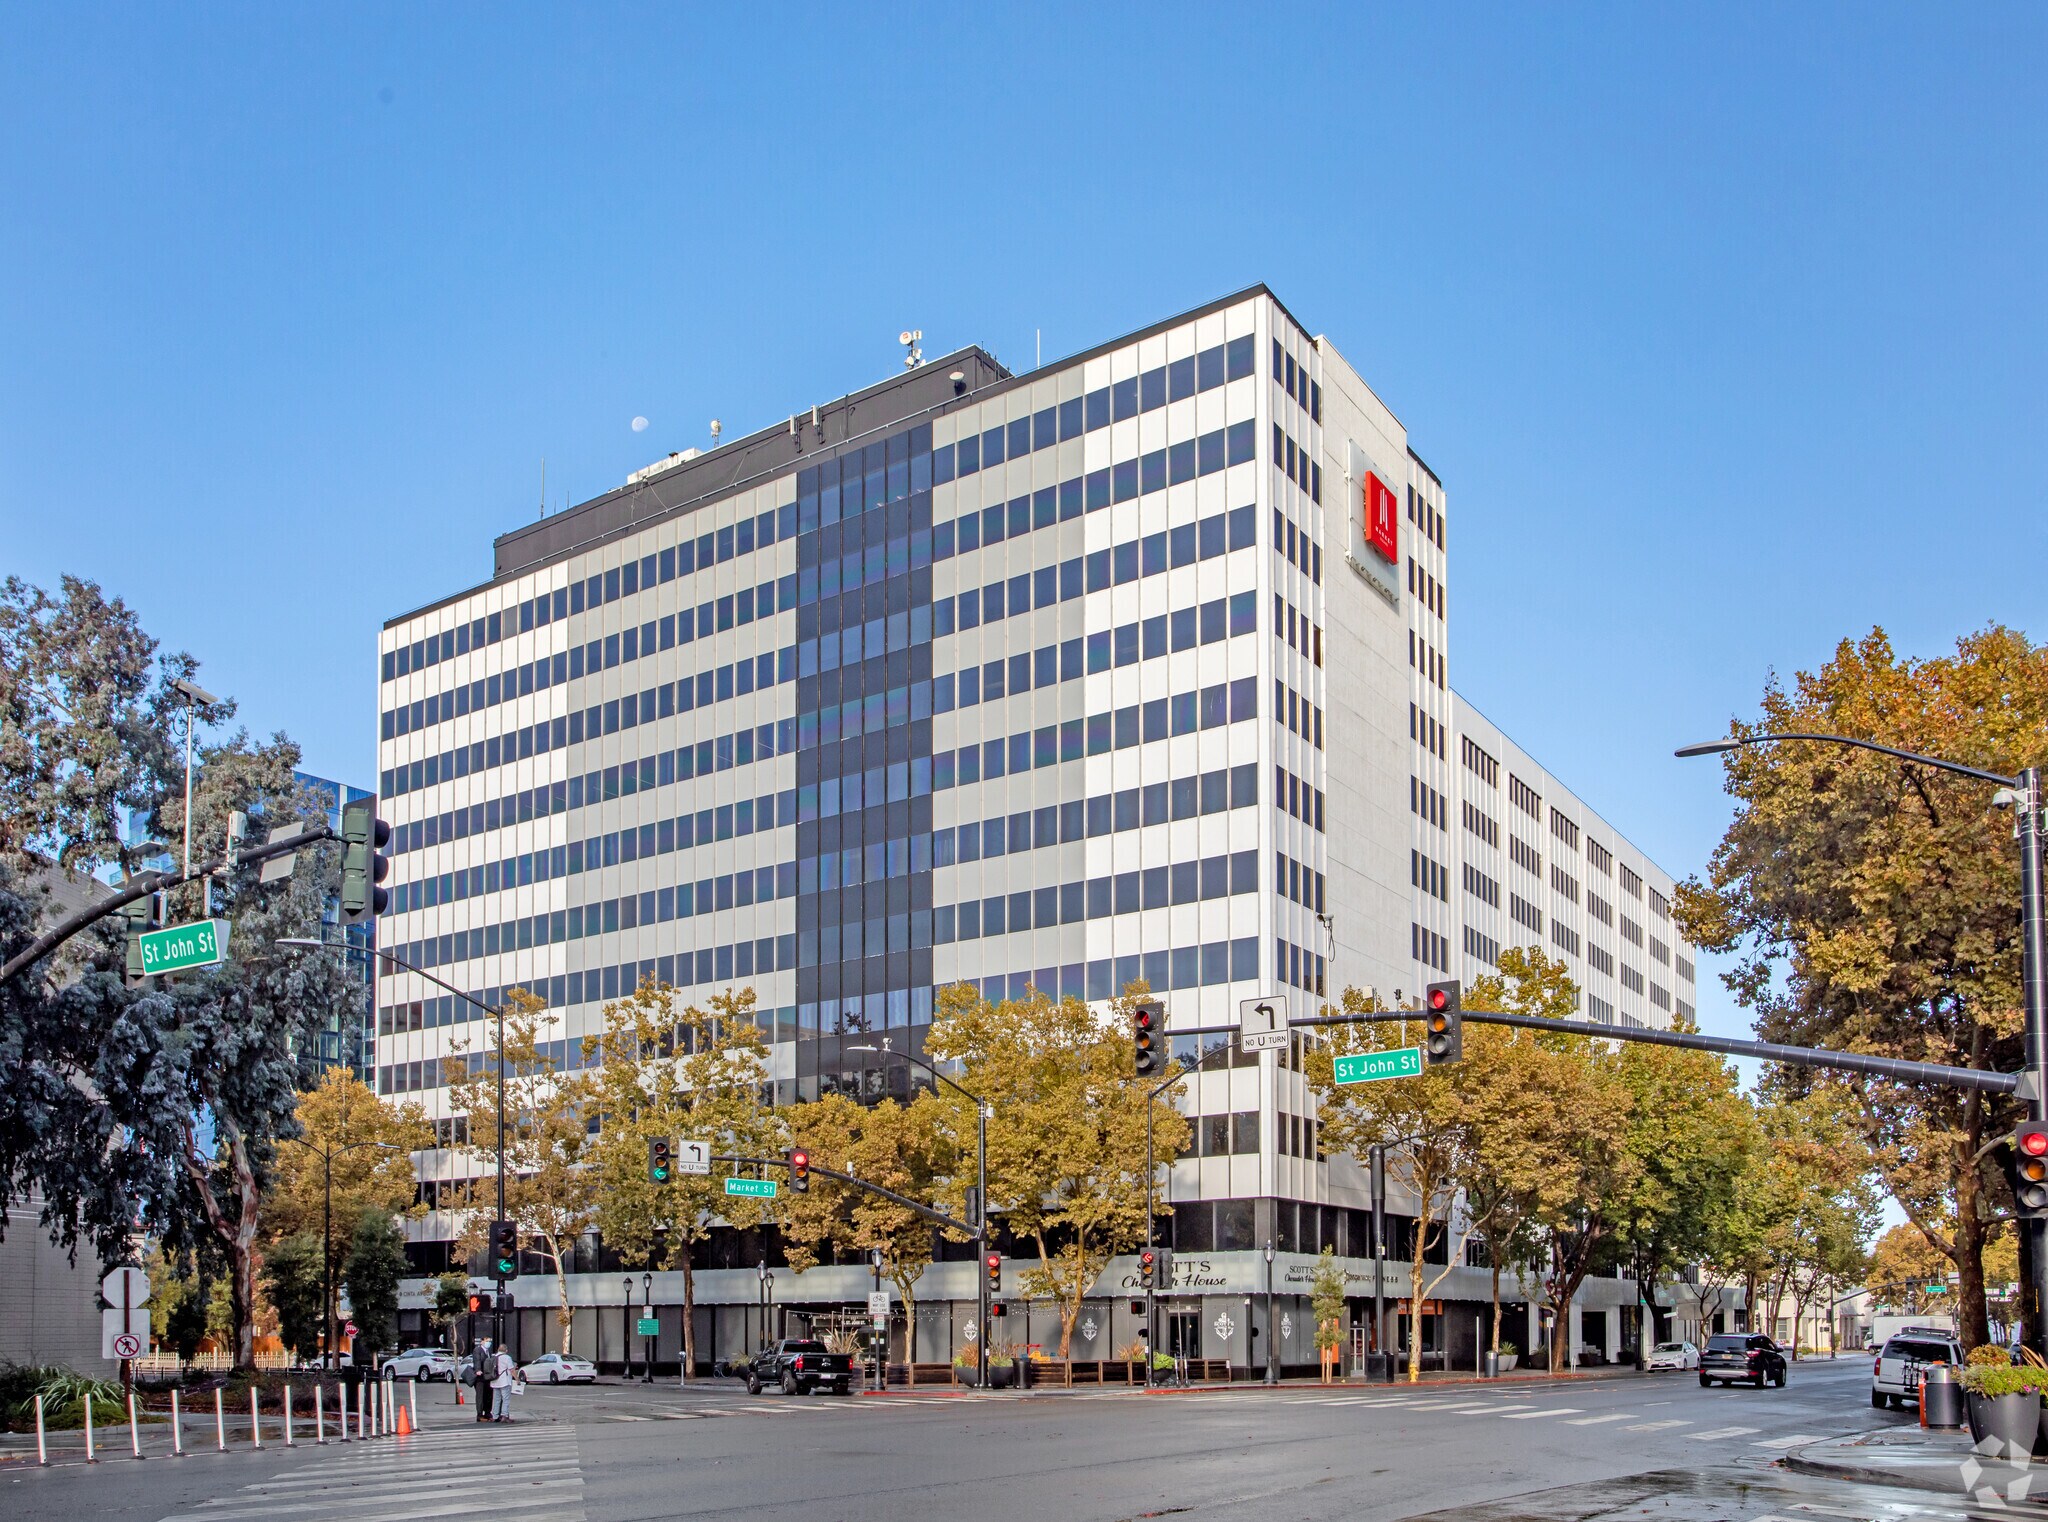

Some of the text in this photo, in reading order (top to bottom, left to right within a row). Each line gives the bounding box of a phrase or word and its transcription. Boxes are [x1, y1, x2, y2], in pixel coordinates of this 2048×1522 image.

[144, 932, 214, 964] St John St
[1245, 1035, 1286, 1047] NO U TURN
[1338, 1055, 1417, 1077] St John St
[729, 1182, 773, 1194] Market St
[1137, 1260, 1211, 1274] TT'S
[1182, 1274, 1227, 1287] House
